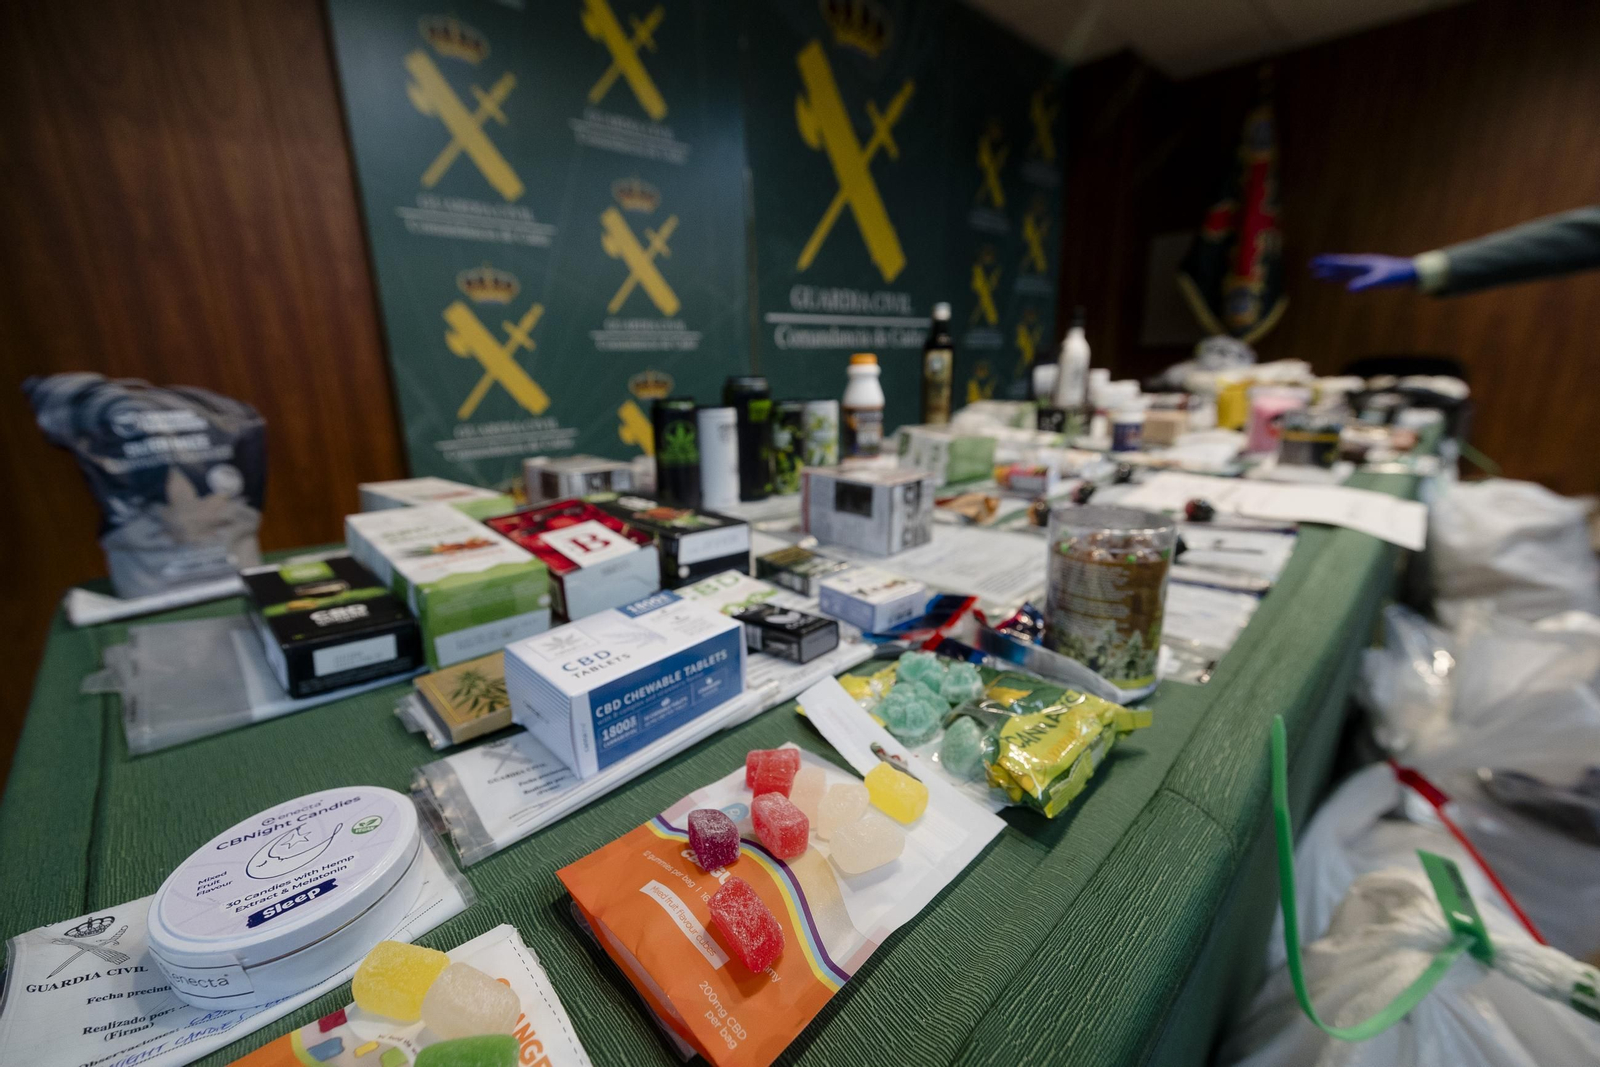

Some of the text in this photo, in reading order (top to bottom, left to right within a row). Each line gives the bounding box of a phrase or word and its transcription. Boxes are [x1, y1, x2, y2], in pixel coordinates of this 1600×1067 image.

[562, 650, 611, 672] CBD
[572, 653, 631, 679] TABLETS
[595, 699, 622, 718] CBD
[623, 670, 682, 705] CHEWABLE
[683, 649, 728, 677] TABLETS
[216, 796, 361, 851] CBNight Candies
[278, 801, 321, 820] enecta
[196, 880, 233, 897] Flavour
[197, 879, 220, 891] Fruit
[198, 871, 228, 885] Mixed
[225, 855, 355, 910] 30 Candies with Hemp
[235, 865, 347, 914] Extract & Melatonin
[671, 868, 684, 878] per
[681, 874, 696, 889] bag
[262, 887, 321, 919] Sleep
[650, 886, 717, 957] Mixed fruit flavour cubes
[26, 966, 149, 993] GUARDIA CIVIL
[86, 992, 124, 1005] Fecha
[699, 980, 747, 1040] 200mg CBD
[82, 1007, 176, 1035] Realizado por:
[103, 1022, 154, 1042] (Firma)
[704, 1010, 738, 1050] per bag
